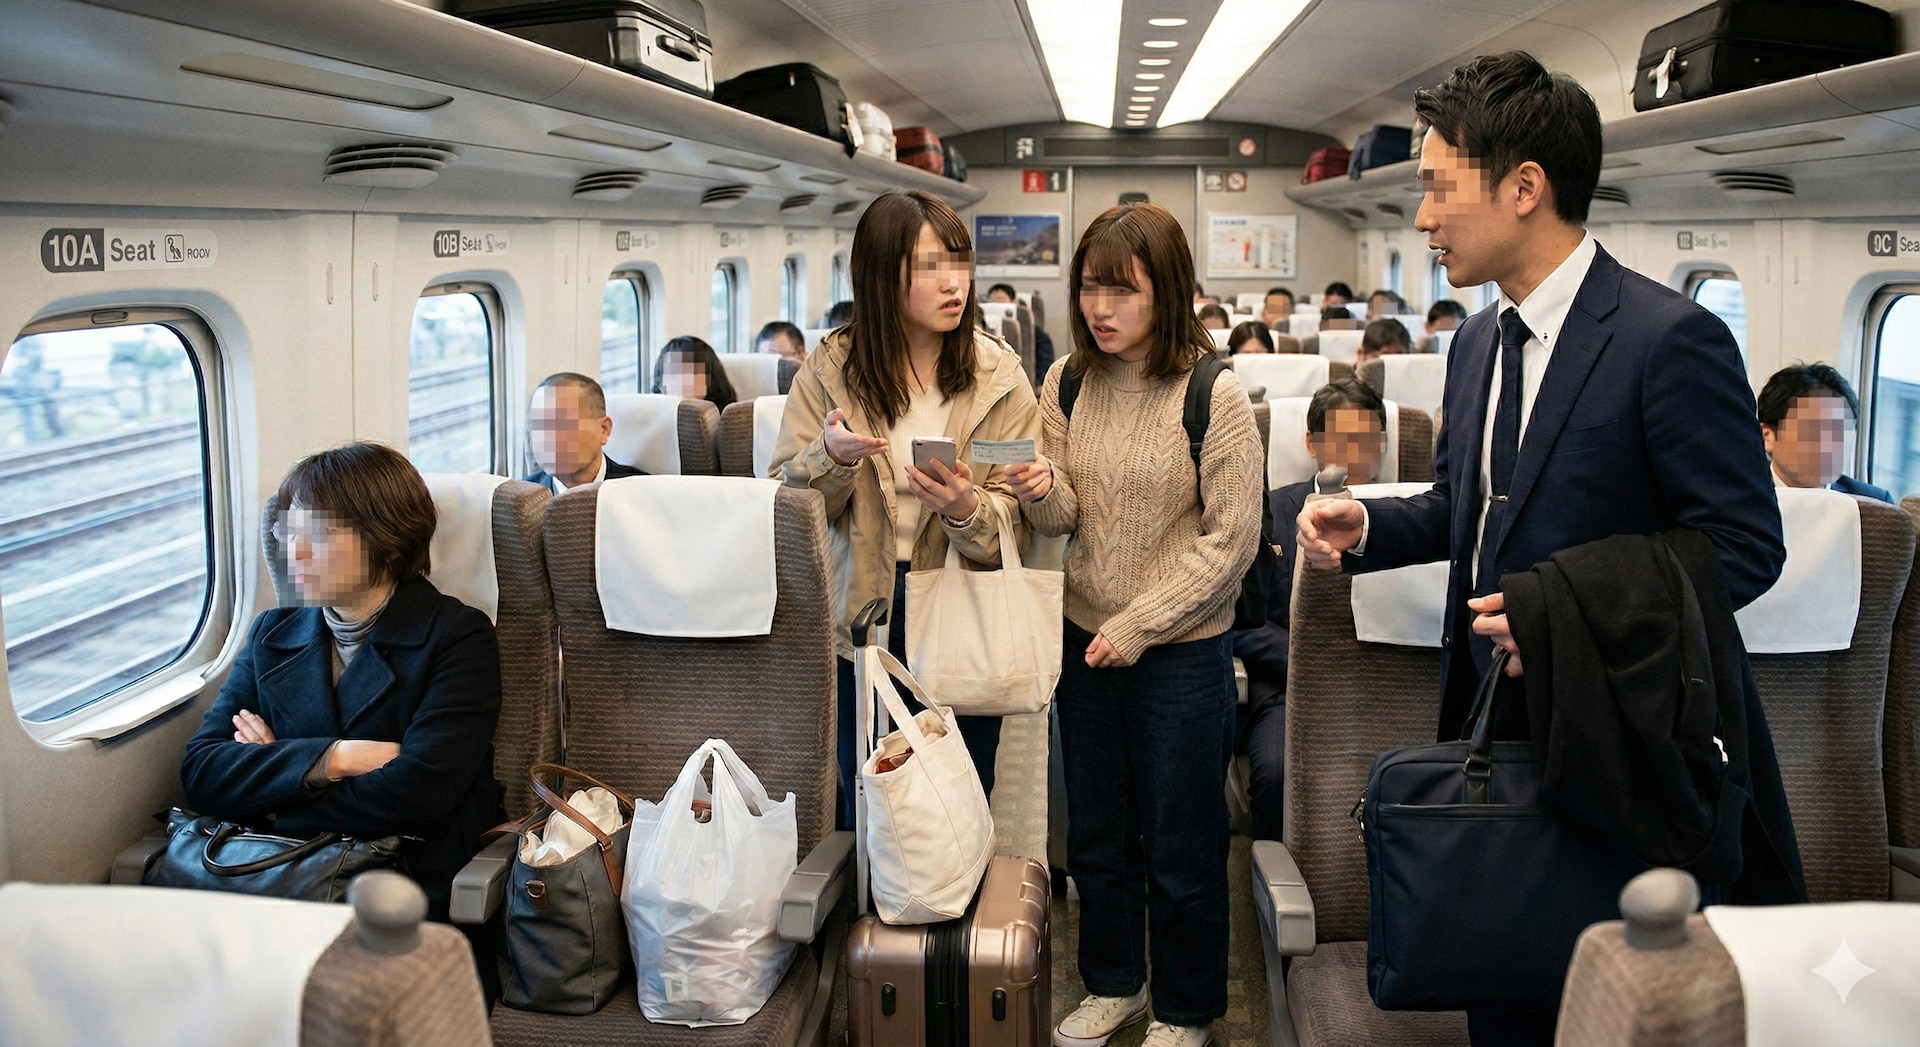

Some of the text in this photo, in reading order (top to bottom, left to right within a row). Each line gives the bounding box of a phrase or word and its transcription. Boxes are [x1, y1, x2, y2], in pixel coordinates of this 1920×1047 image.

[49, 234, 211, 267] 10A Seat ROOV
[436, 233, 458, 255] 10B
